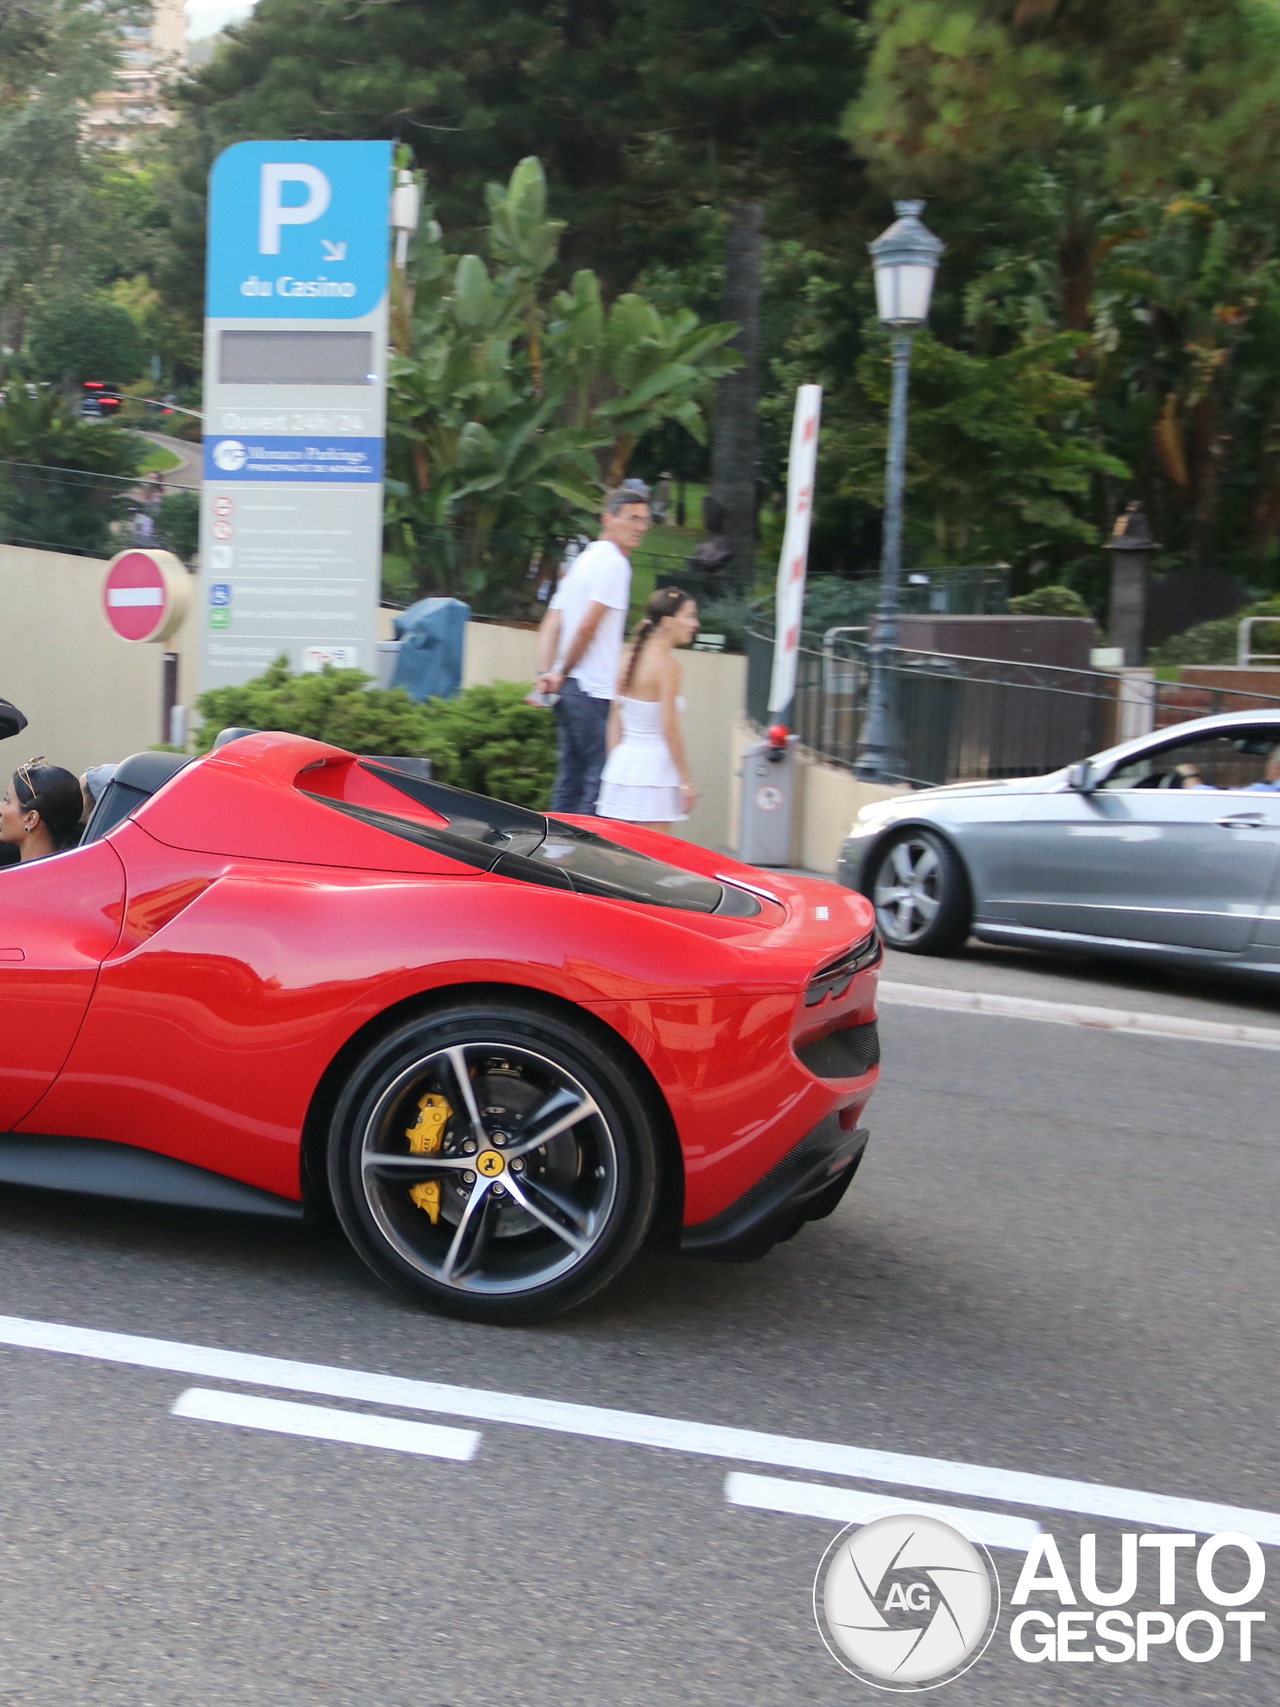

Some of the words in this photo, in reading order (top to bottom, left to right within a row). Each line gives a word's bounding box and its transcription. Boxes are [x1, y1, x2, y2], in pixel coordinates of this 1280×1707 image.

[259, 163, 332, 254] P
[240, 275, 273, 297] du
[275, 276, 357, 298] Casino
[221, 412, 287, 430] Ouvert
